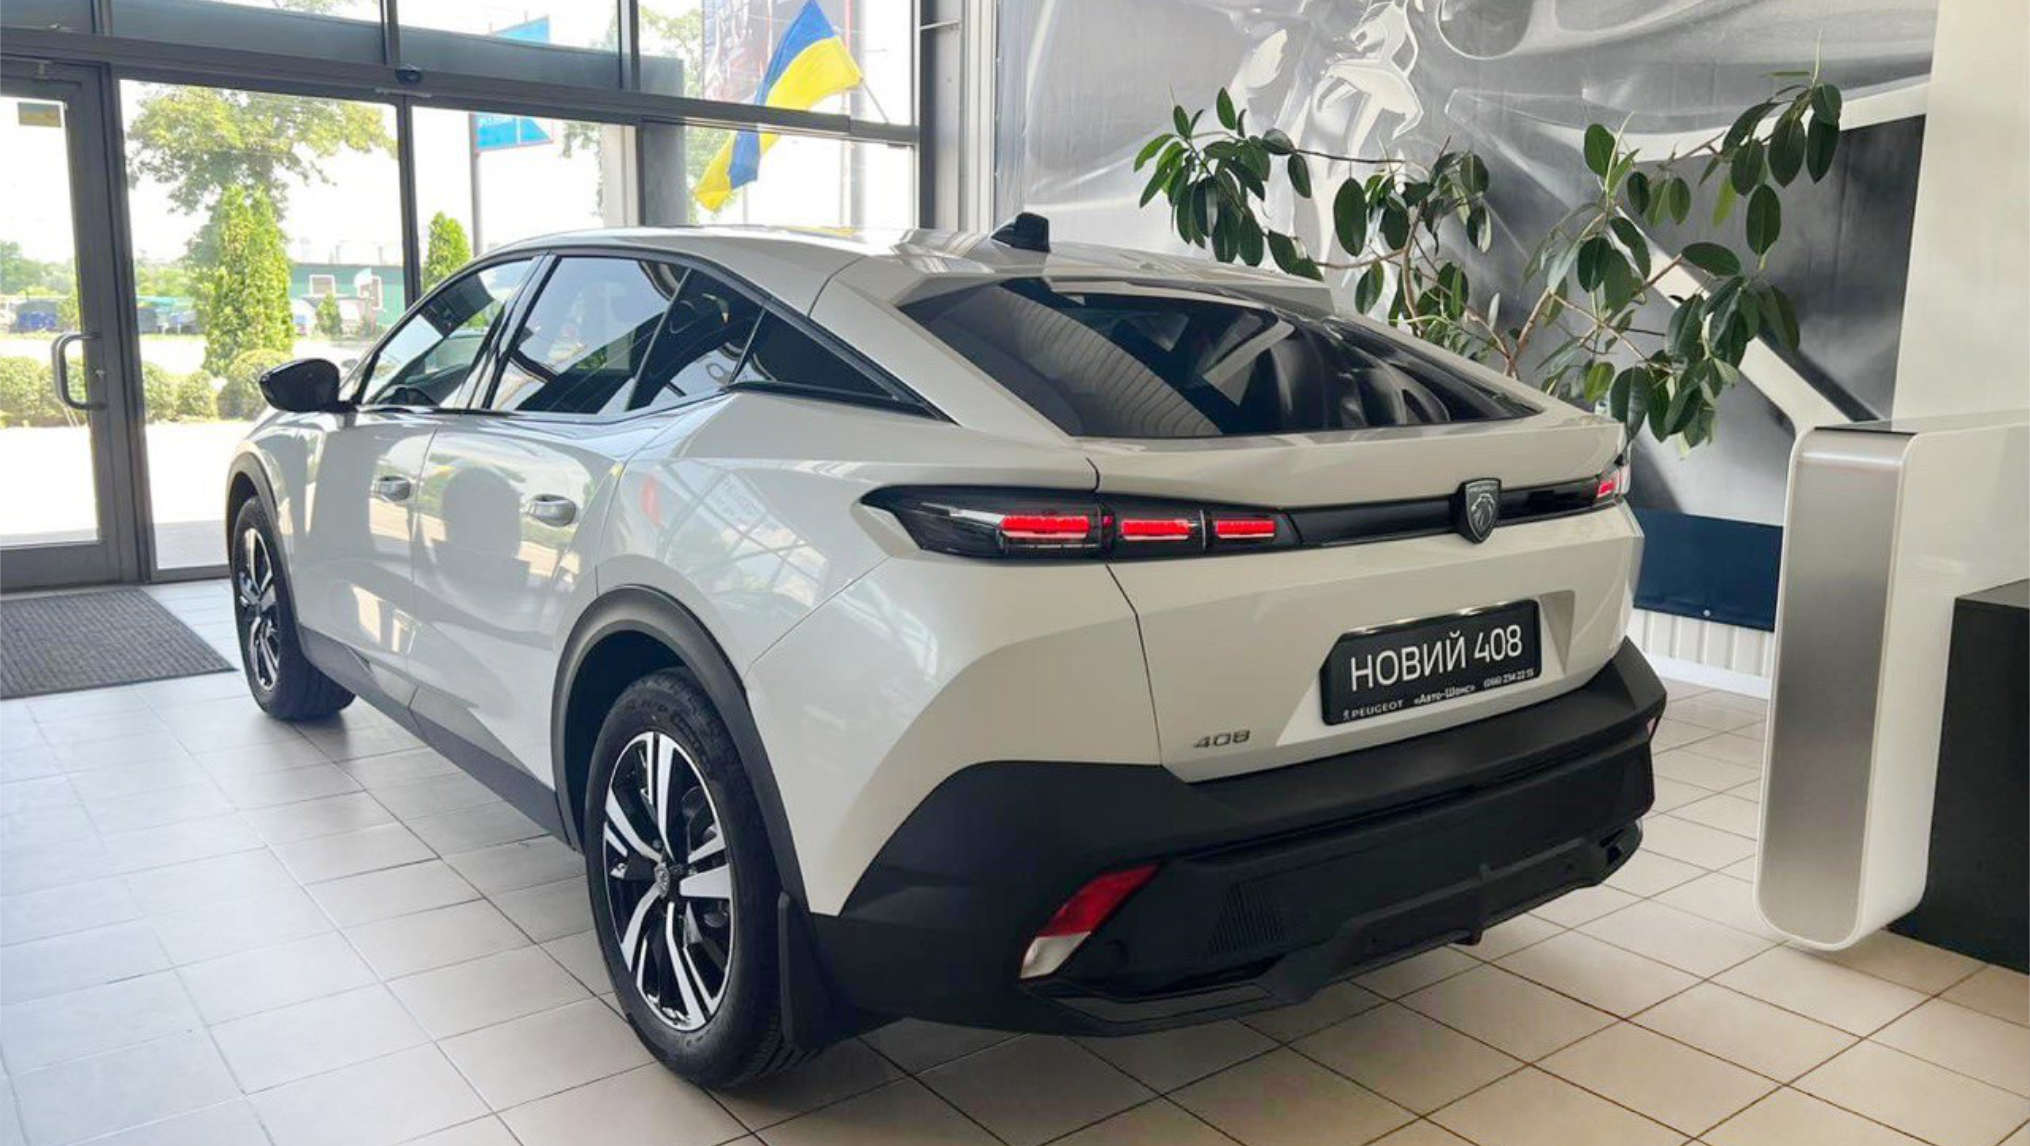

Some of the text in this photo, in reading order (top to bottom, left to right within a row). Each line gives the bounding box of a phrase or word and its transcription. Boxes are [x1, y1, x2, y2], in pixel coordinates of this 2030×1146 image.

[1350, 624, 1523, 692] НОВИЙ 408
[1351, 699, 1404, 718] PEUGEOT
[1193, 730, 1251, 748] 408
